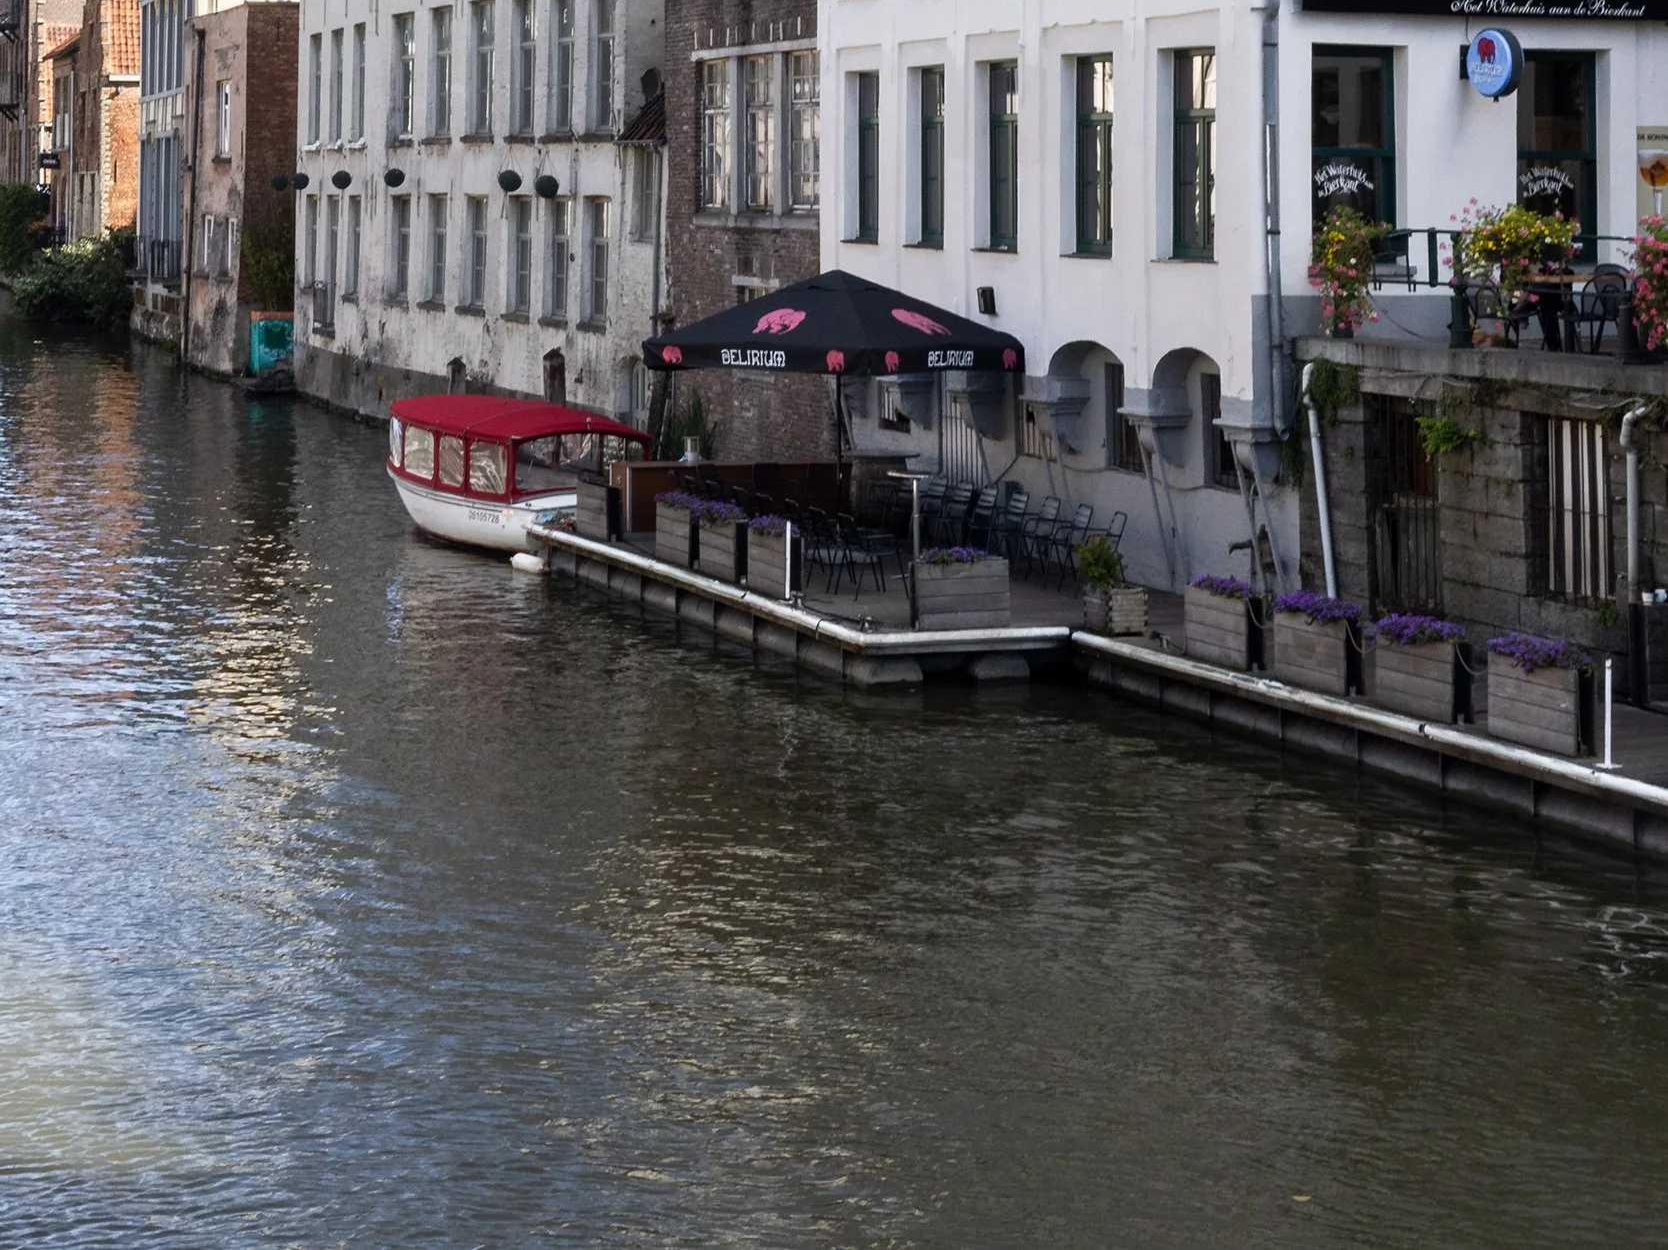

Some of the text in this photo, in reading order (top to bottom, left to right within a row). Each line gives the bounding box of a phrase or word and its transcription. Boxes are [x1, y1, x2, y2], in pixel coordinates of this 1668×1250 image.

[1549, 6, 1571, 15] aan
[1573, 1, 1587, 16] de
[721, 348, 786, 368] DELIRIUM
[928, 349, 975, 368] DELIRIUM
